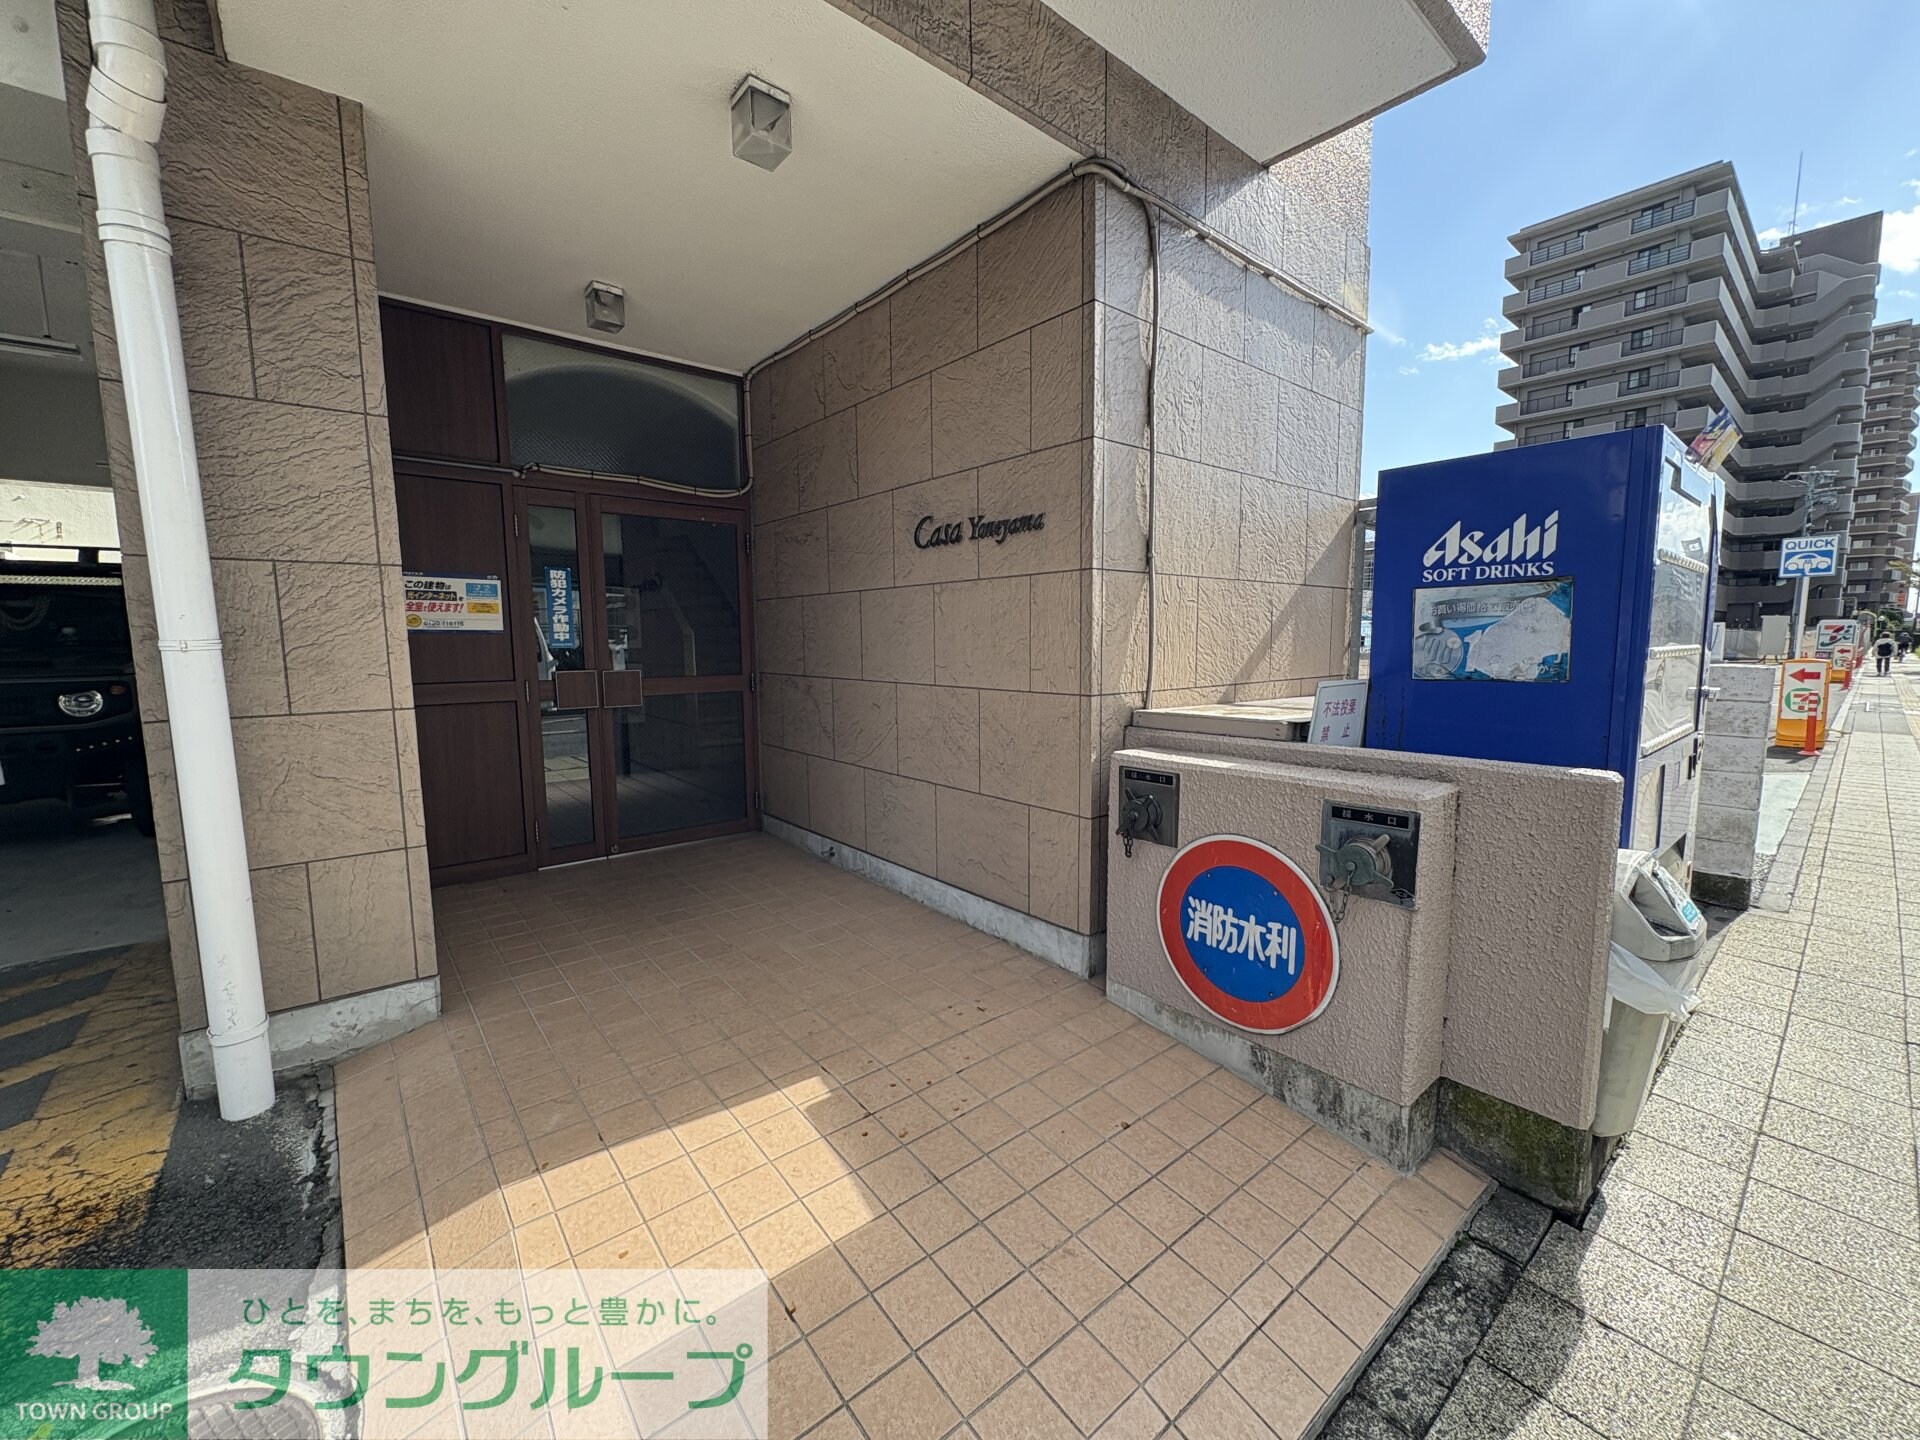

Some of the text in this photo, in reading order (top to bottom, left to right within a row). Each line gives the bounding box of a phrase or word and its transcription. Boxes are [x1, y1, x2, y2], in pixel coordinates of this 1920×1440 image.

[914, 512, 1046, 549] Casa Yoneyama
[1422, 509, 1560, 568] Asahi
[1785, 538, 1836, 551] QUICK
[1422, 560, 1554, 583] SOFT DRINKS
[549, 569, 570, 642] 防犯カメラ作動中
[1186, 896, 1297, 976] 消防水利
